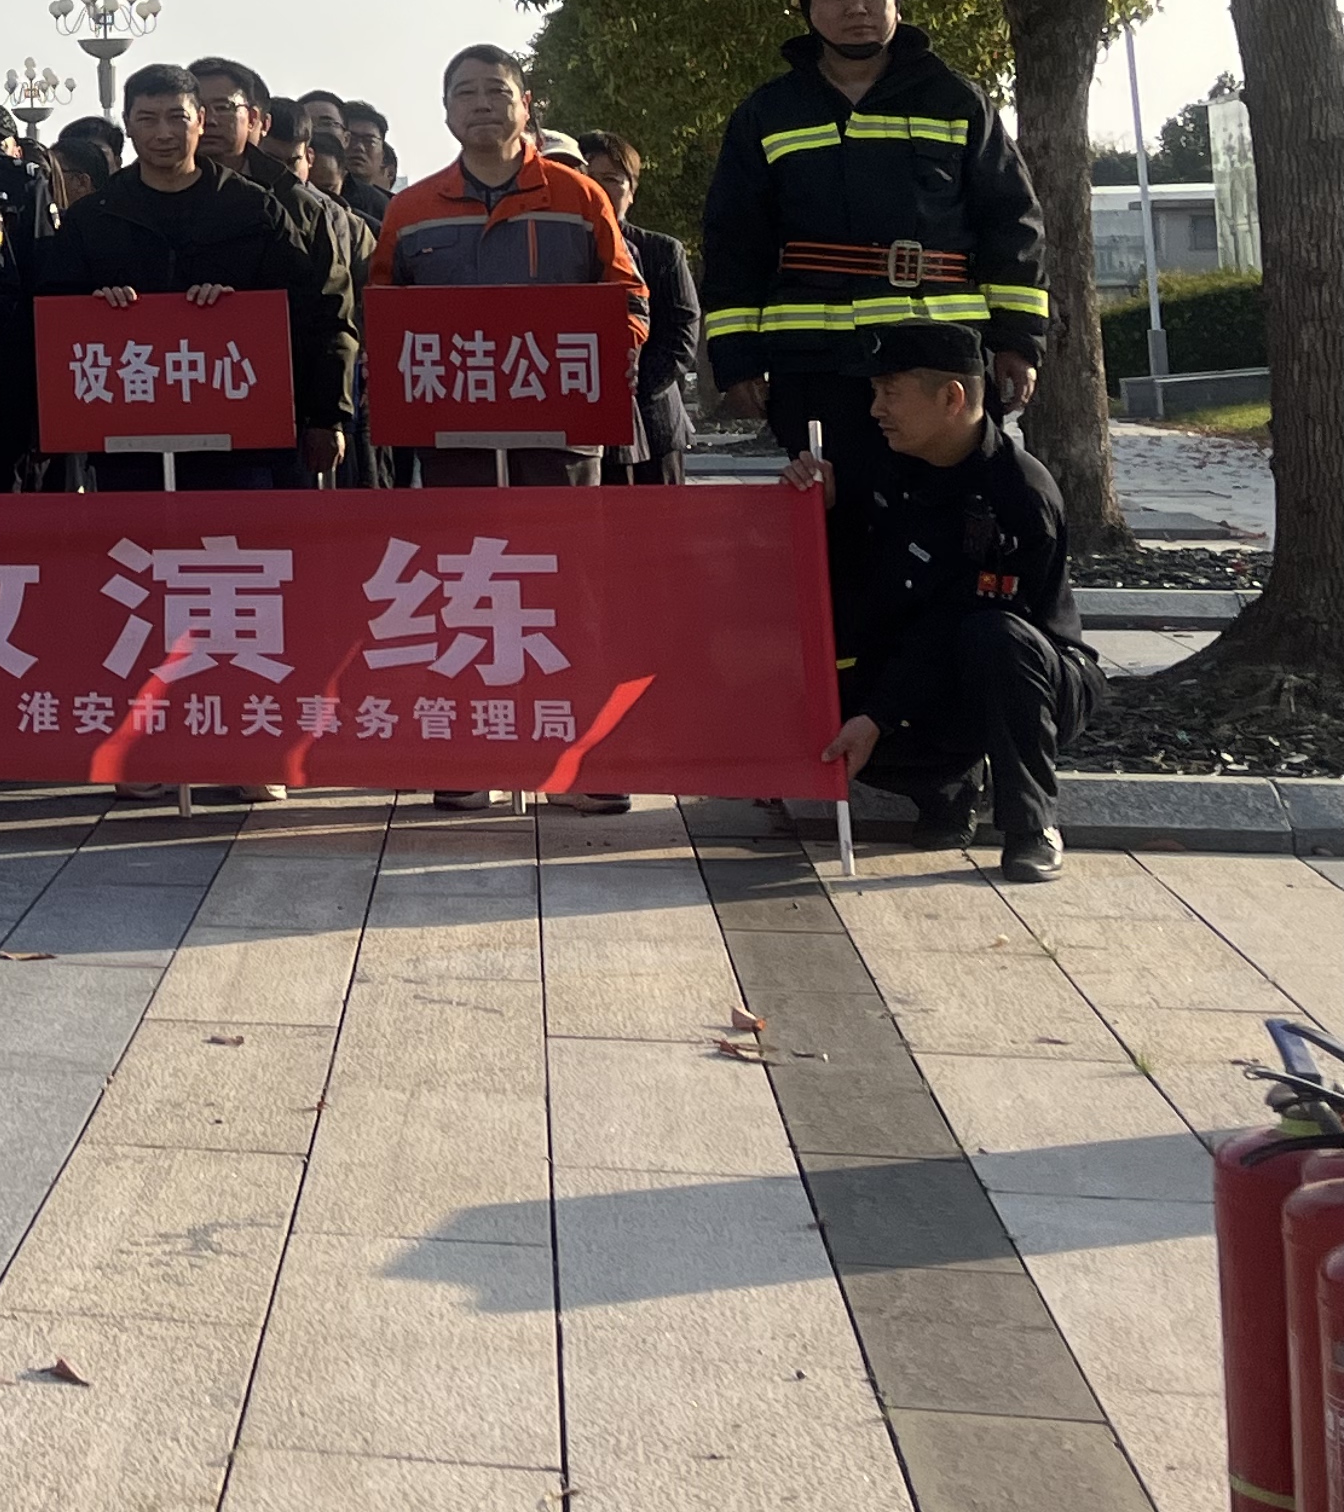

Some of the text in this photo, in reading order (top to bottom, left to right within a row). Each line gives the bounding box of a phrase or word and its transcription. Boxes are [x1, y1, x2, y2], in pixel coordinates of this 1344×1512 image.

[69, 339, 257, 404] 设备中心
[398, 330, 601, 403] 保洁公司
[18, 692, 576, 742] 淮安市机关事务管理局
